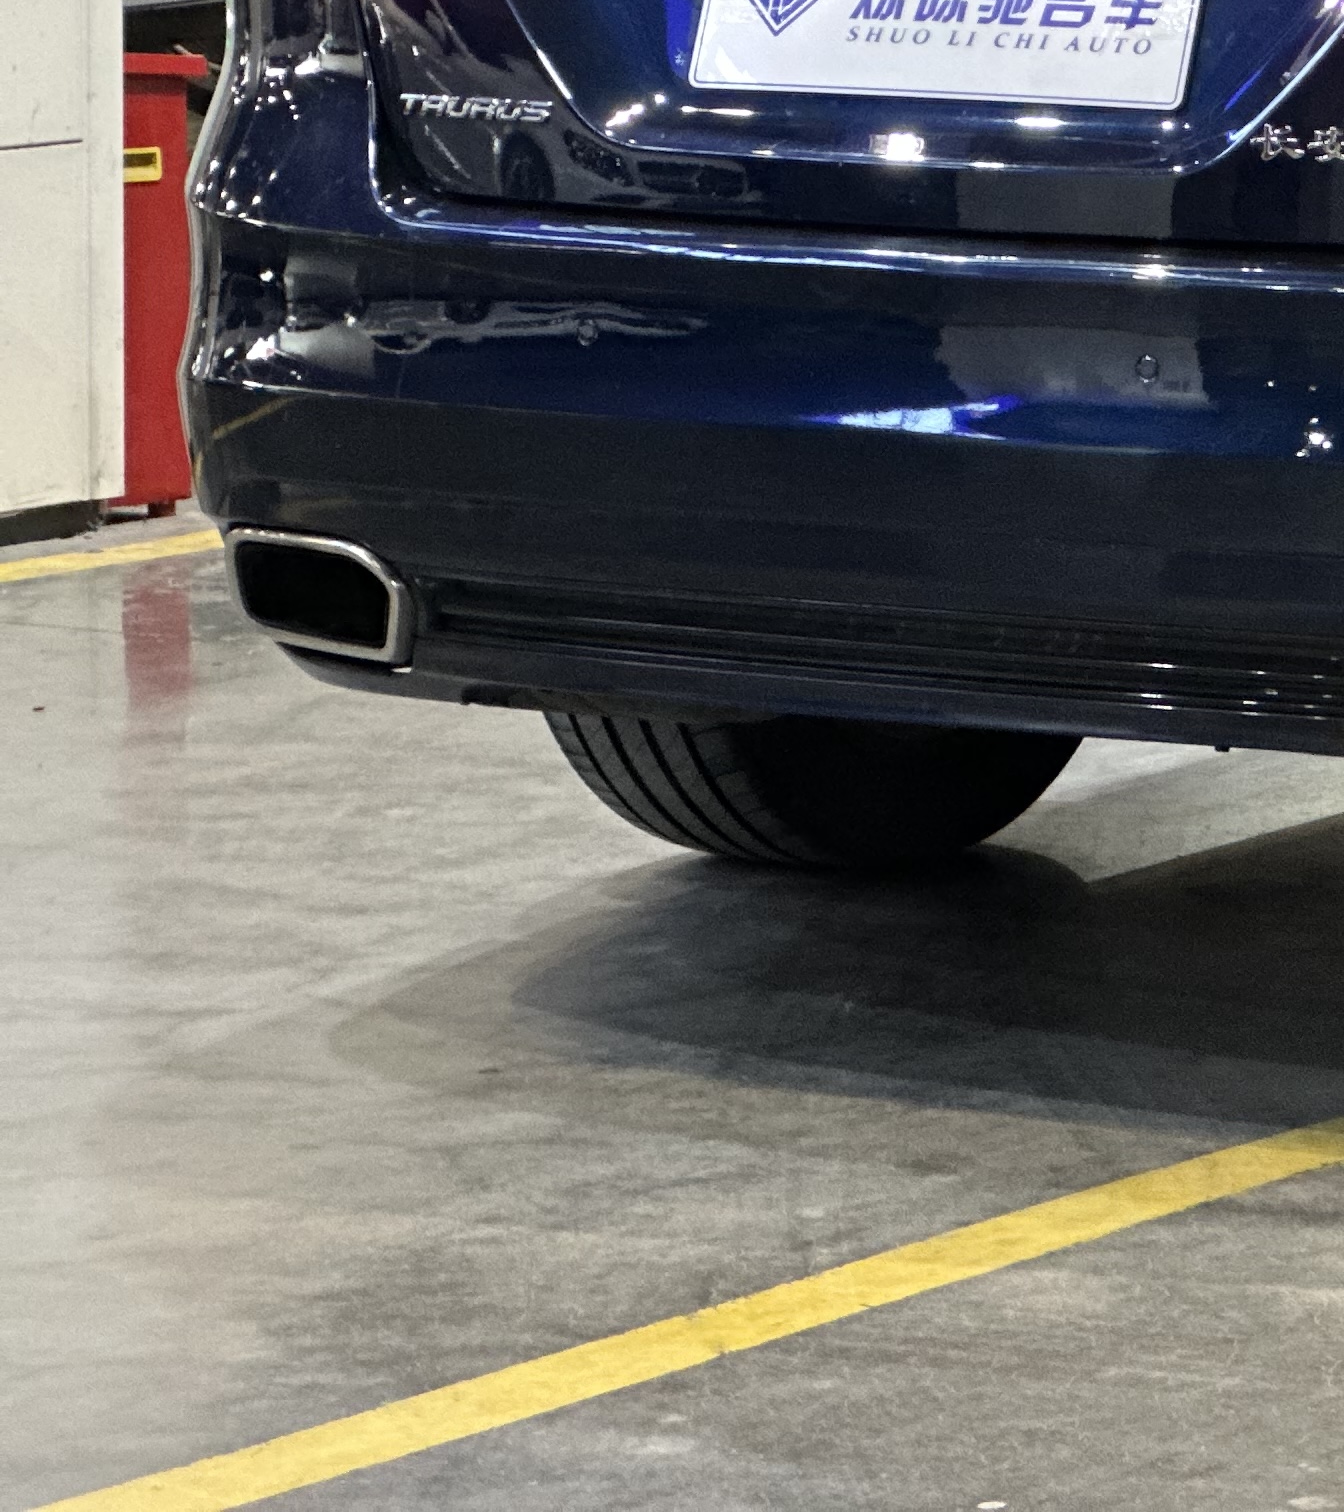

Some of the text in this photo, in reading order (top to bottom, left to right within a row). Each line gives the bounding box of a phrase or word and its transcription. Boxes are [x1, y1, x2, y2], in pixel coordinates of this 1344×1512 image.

[845, 25, 1153, 55] SHUO LI CHI AUTO
[400, 93, 553, 123] TAURUS
